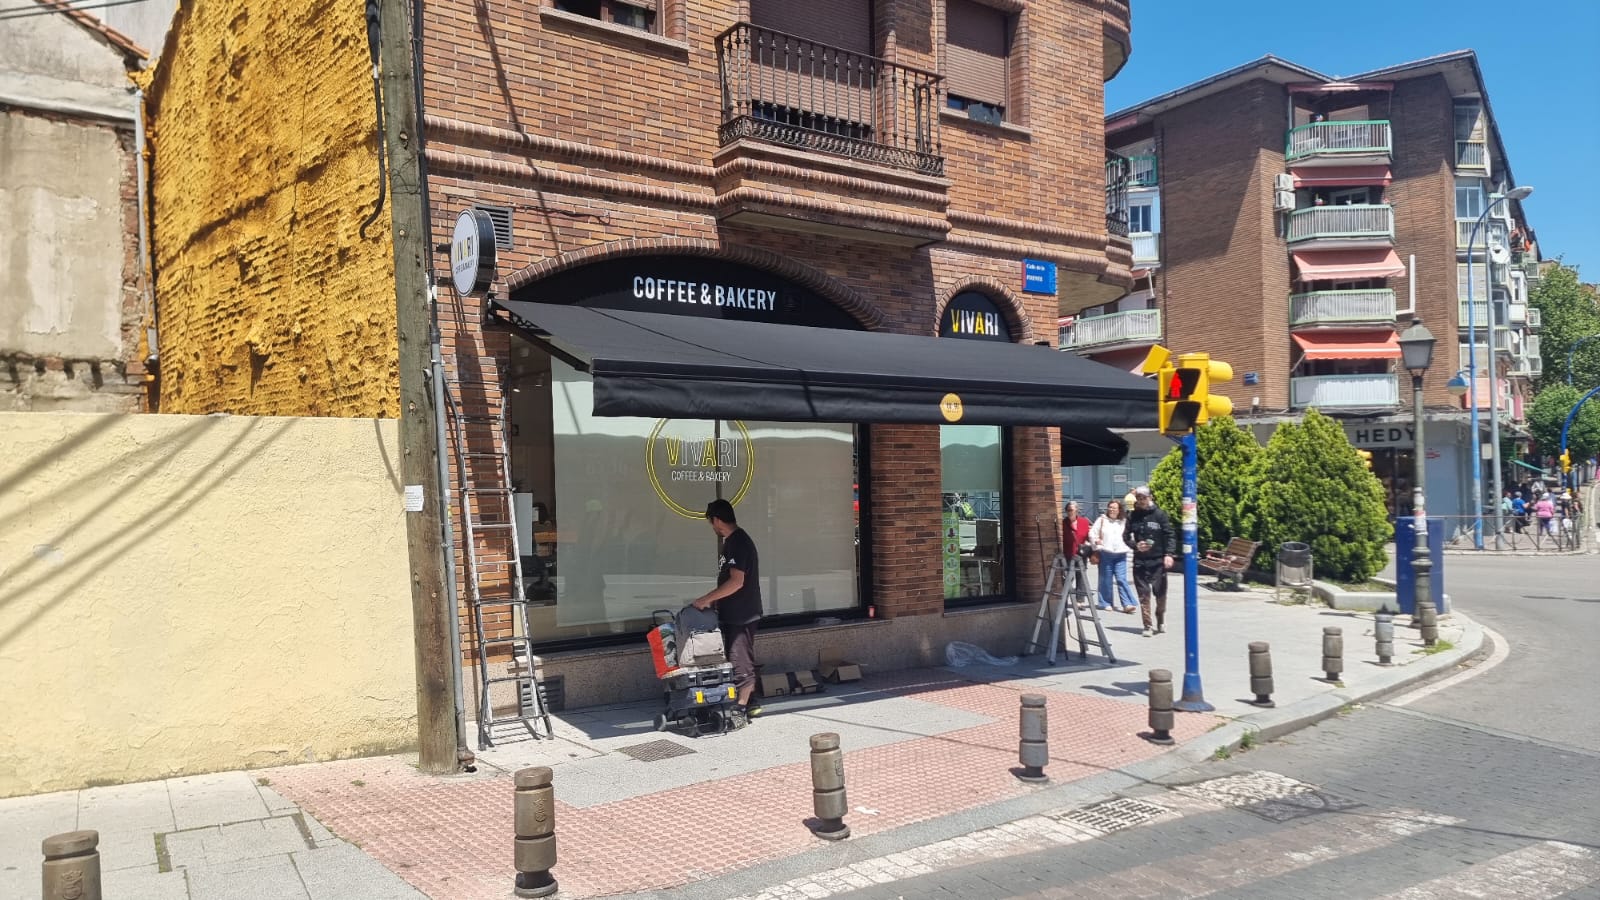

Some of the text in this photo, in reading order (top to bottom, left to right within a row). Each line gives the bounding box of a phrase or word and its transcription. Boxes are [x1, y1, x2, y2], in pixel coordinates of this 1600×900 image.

[633, 275, 776, 311] COFFEE & BAKERY
[950, 309, 999, 336] VIVARI
[665, 435, 738, 468] VIVARI
[671, 470, 697, 481] COFFEE
[705, 471, 731, 482] BAKERY
